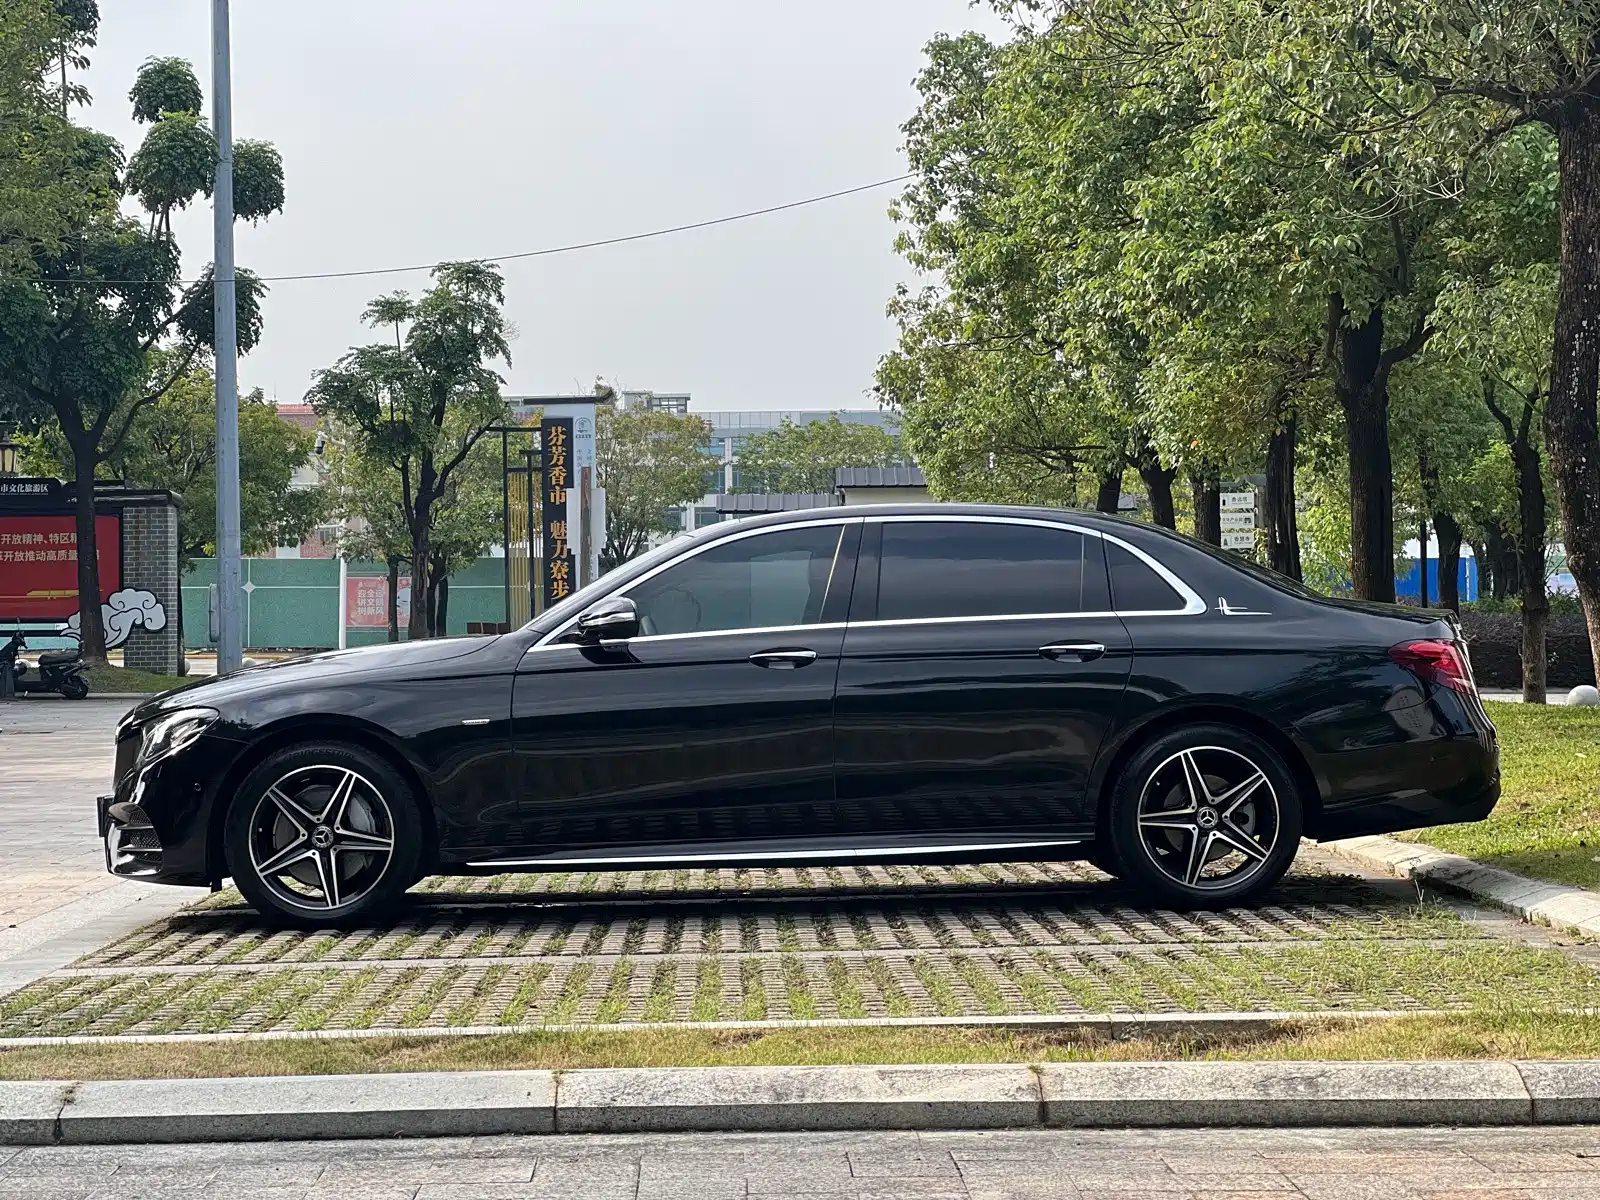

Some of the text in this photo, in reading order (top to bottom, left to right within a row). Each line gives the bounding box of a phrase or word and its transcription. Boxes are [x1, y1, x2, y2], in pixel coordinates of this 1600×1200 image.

[1, 484, 49, 493] 市文化旅游区
[547, 426, 570, 600] 芬芳香市 魅力寮步
